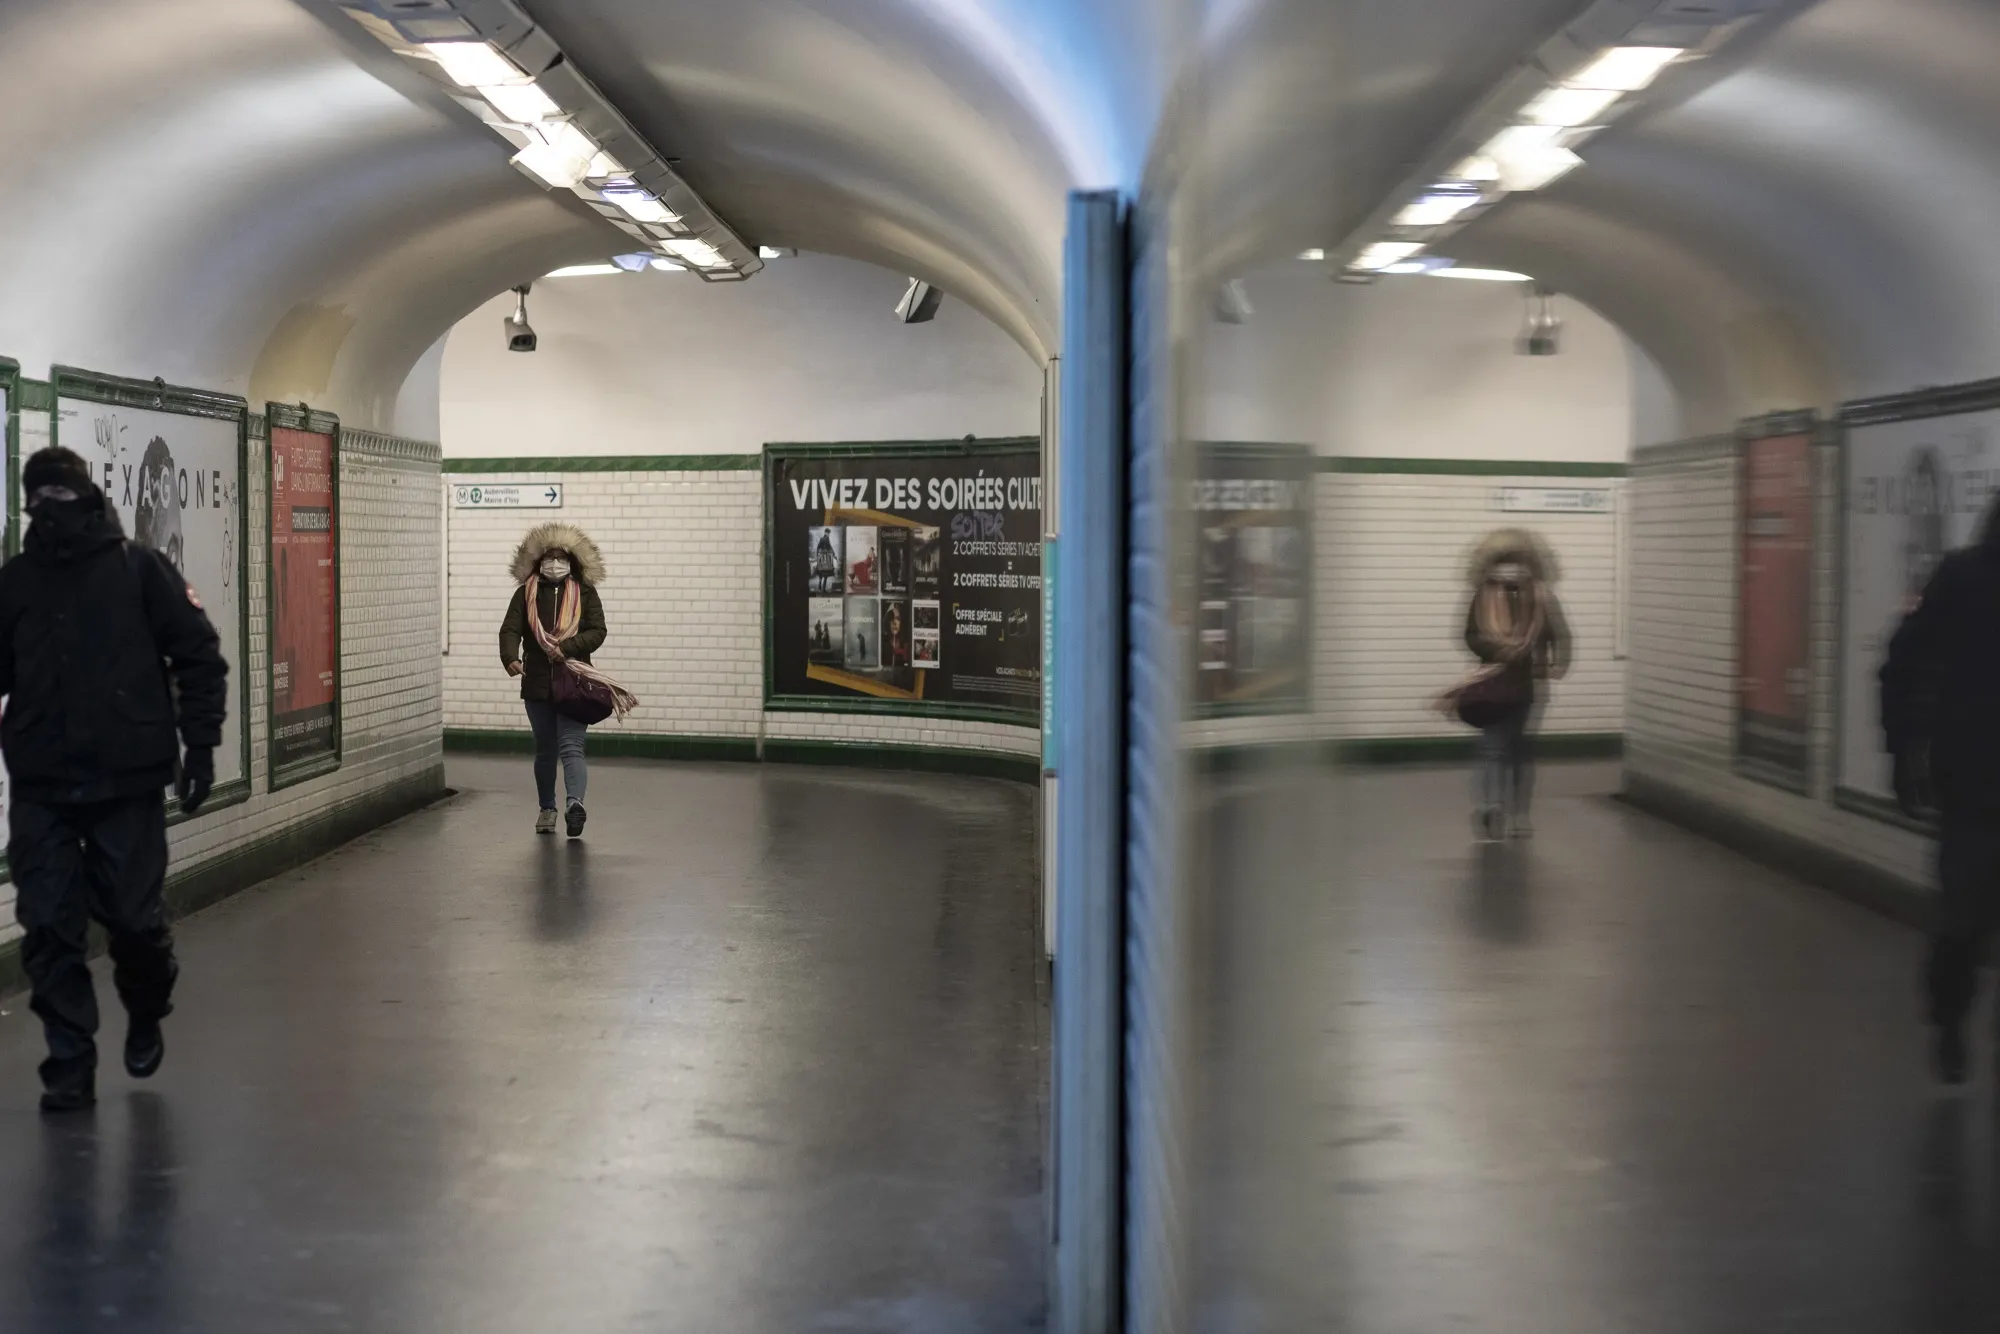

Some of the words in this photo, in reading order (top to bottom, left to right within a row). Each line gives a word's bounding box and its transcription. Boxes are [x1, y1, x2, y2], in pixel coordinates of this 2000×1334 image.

[472, 490, 481, 502] 12
[484, 487, 520, 495] Aubervilliers
[789, 479, 869, 510] VIVEZ
[875, 477, 922, 510] DES
[927, 469, 1005, 511] SOIRÉES
[484, 496, 502, 504] Mairie
[953, 541, 959, 555] 2
[960, 541, 997, 555] COFFRETS
[1017, 542, 1026, 556] TV
[953, 573, 960, 586] 2
[960, 573, 998, 587] COFFRETS
[998, 571, 1019, 588] SÉRIES
[1019, 575, 1027, 588] TV
[955, 609, 976, 621] OFFRE
[976, 607, 1003, 622] SPÉCIALE
[1043, 575, 1053, 666] Contact
[955, 621, 988, 636] ADHÉRENT
[1043, 674, 1053, 735] Point
